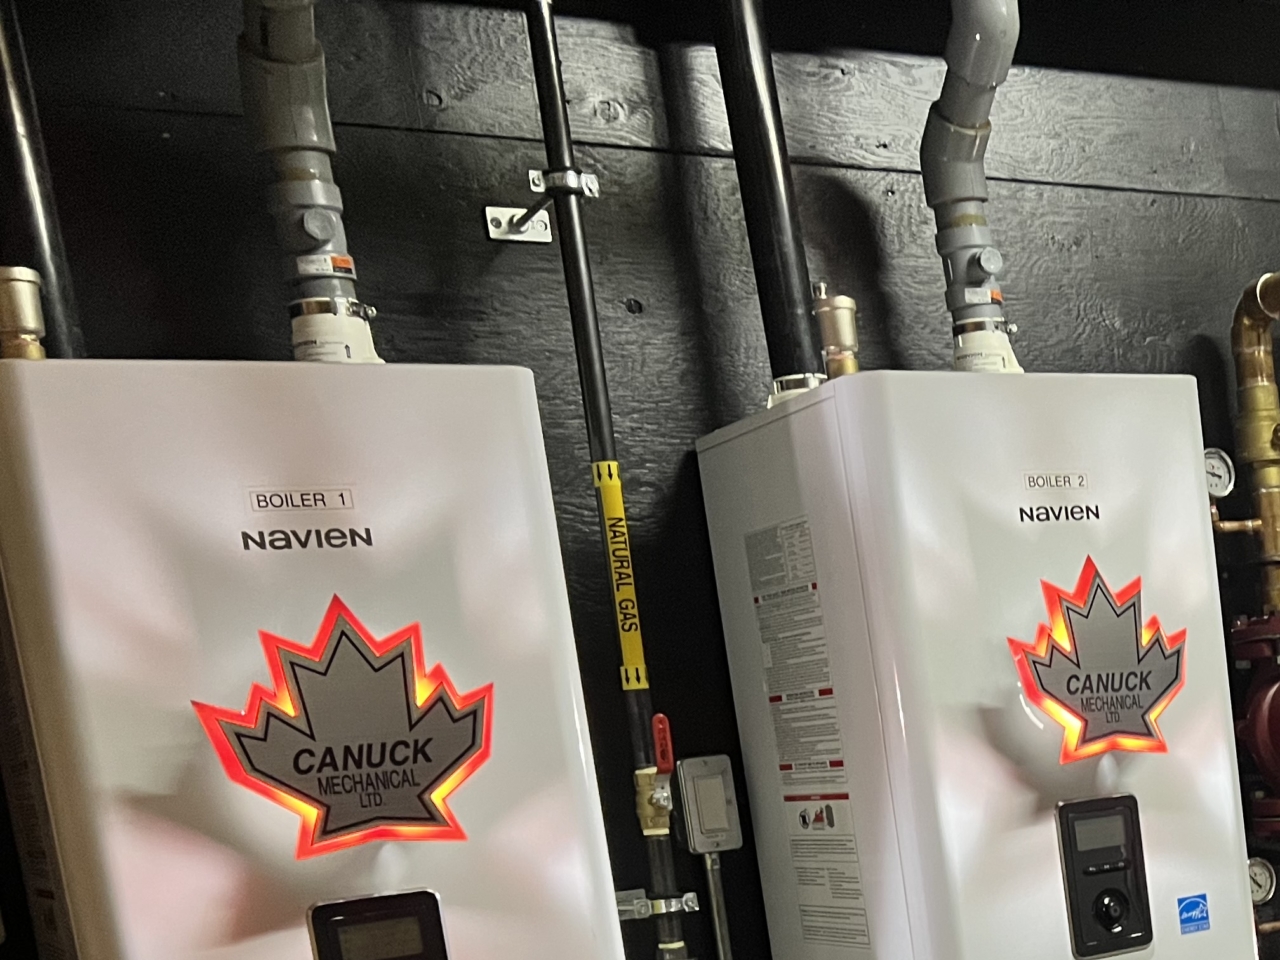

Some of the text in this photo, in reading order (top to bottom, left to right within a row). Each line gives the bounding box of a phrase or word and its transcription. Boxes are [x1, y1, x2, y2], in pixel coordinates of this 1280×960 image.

[1028, 475, 1085, 488] BOILER 2
[256, 492, 346, 508] BOILER 1
[607, 516, 638, 633] NATURAL GAS
[1066, 670, 1152, 695] CANUCK
[1080, 694, 1144, 713] MECHANICAL
[292, 737, 433, 775] CANUCK
[317, 768, 421, 796] MECHANICAL
